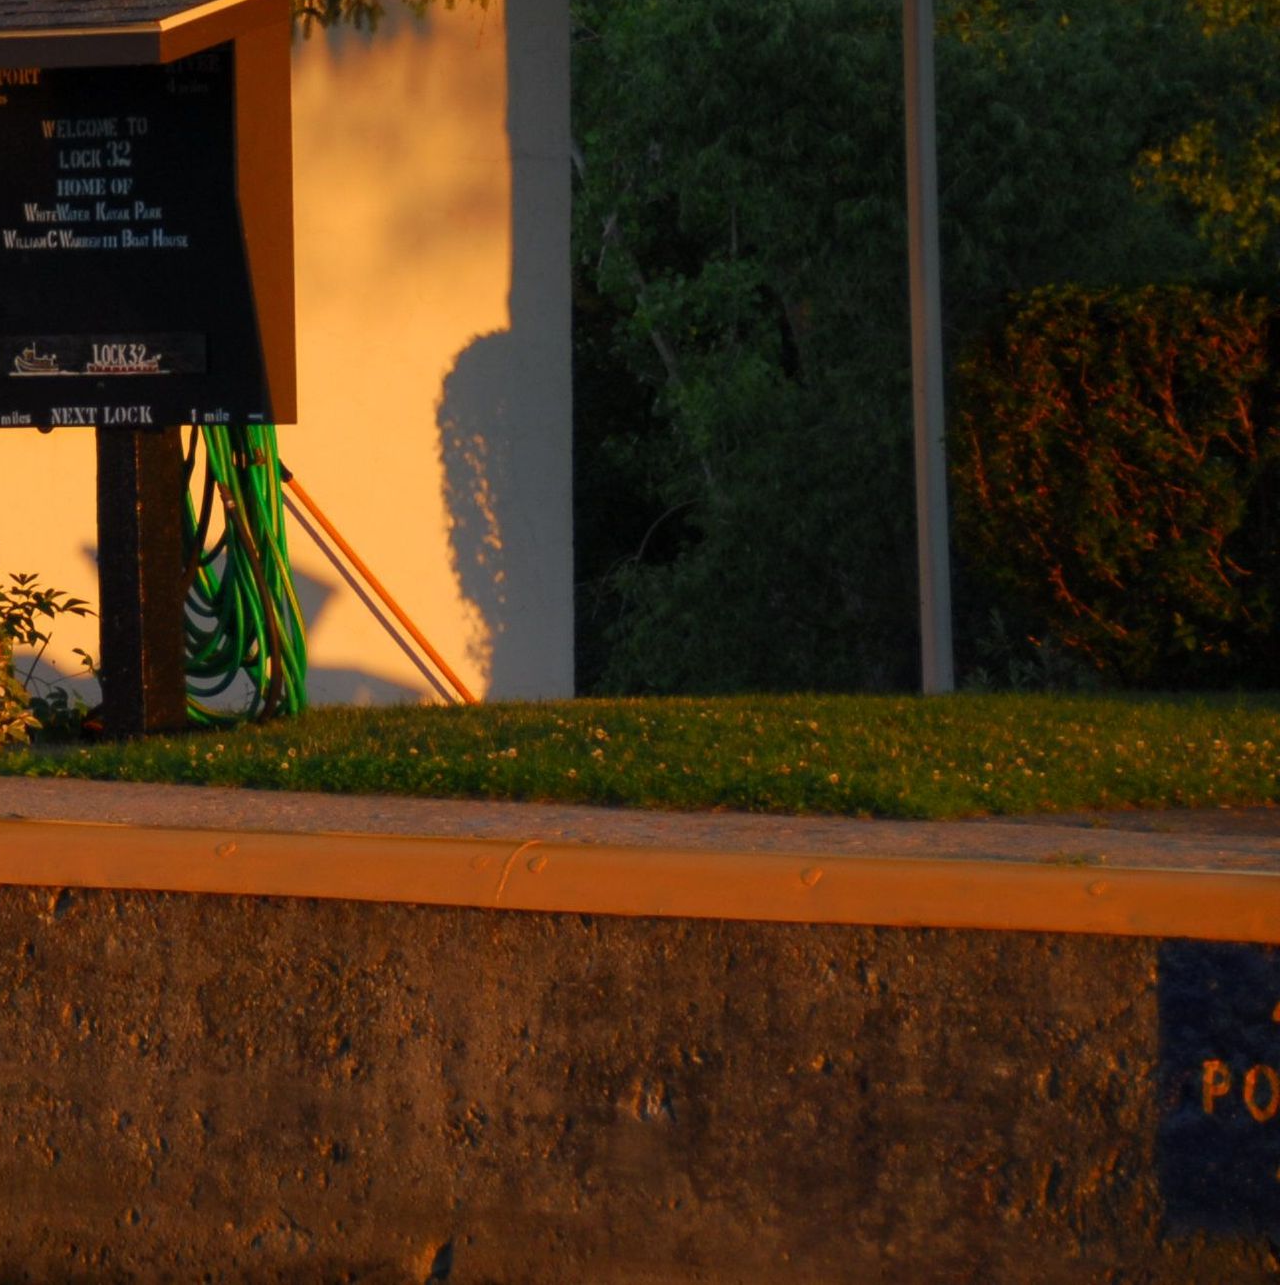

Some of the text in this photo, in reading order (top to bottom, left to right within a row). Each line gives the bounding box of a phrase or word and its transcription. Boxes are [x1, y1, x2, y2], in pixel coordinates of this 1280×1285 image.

[42, 116, 148, 138] WELCOME TO
[59, 140, 131, 169] LOCK 32
[57, 177, 133, 197] HOME OF
[92, 343, 147, 365] LOCK 32
[1, 411, 31, 425] miles
[51, 406, 97, 425] NEXT
[104, 405, 153, 425] LOCK
